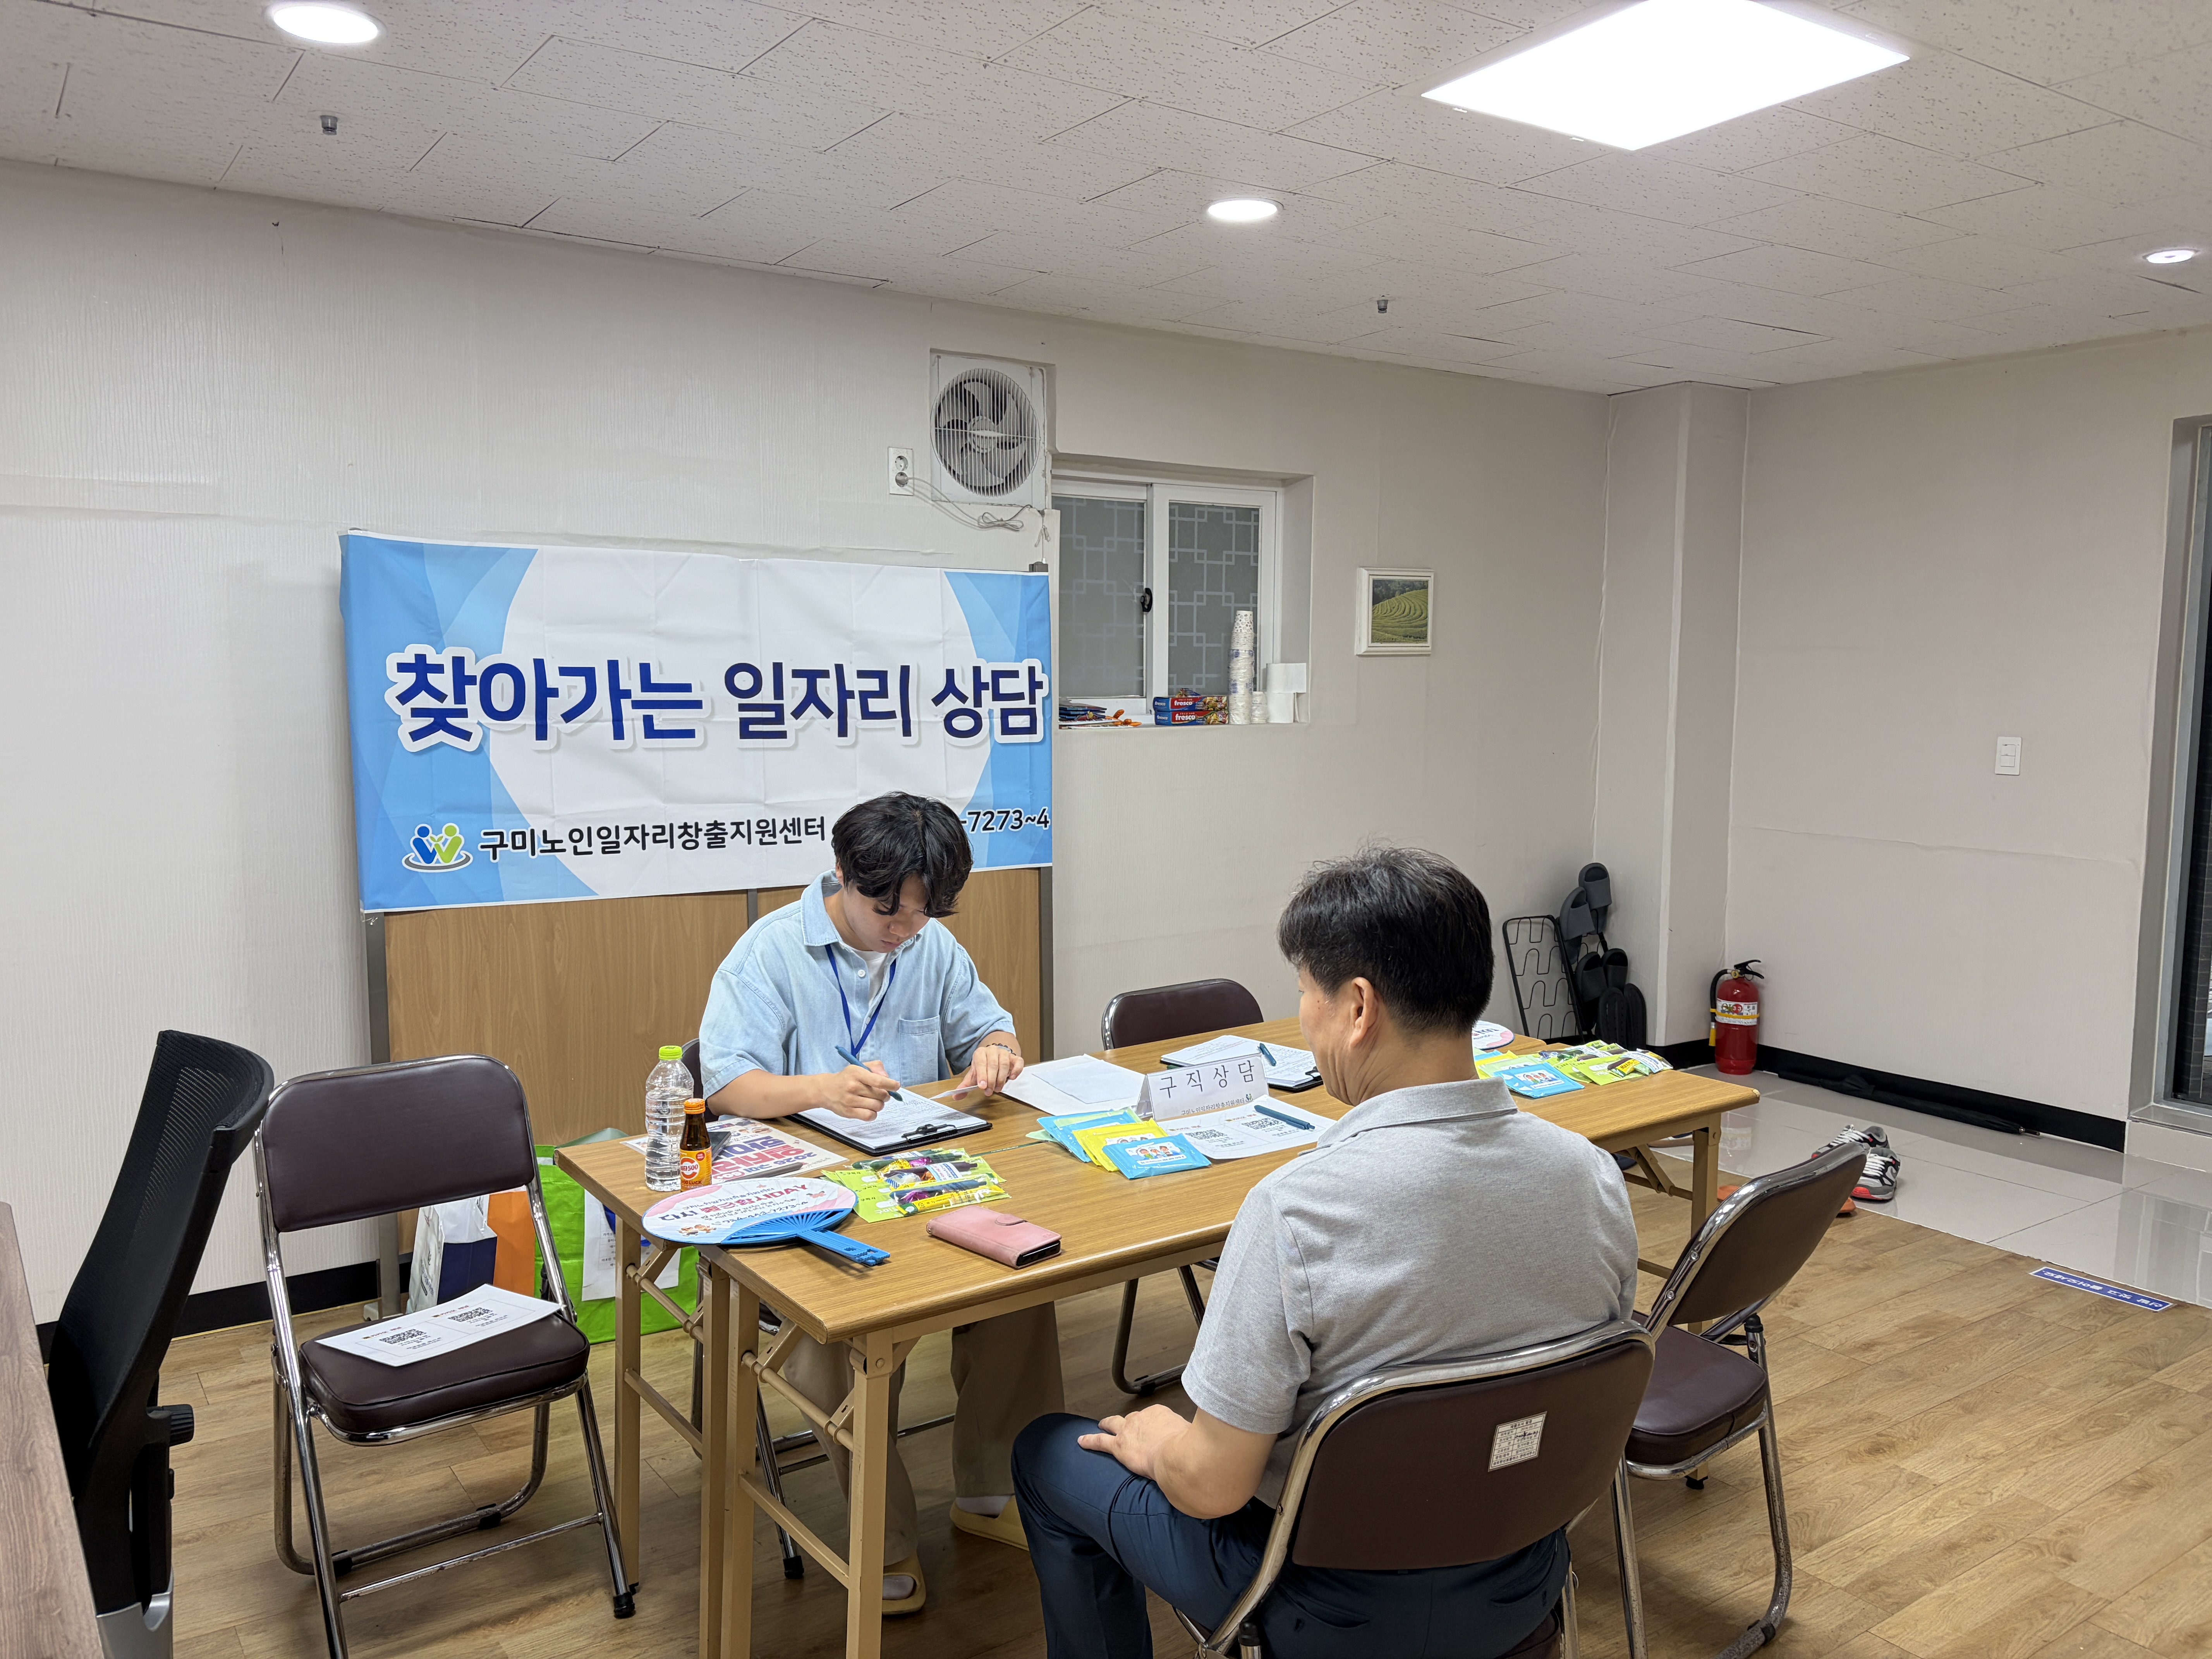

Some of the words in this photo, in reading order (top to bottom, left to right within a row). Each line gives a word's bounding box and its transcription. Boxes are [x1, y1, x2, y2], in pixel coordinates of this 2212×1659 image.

[396, 654, 702, 741] 찾아가는
[725, 663, 911, 739] 일자리
[932, 666, 1043, 738] 상담
[481, 817, 824, 860] 구미노인일자리창출지원센터
[1160, 1060, 1254, 1099] 구직상담
[712, 1144, 805, 1176] 일자리
[718, 1135, 787, 1159] 한마
[773, 1152, 817, 1165] 2026
[743, 1164, 773, 1173] 구미
[658, 1210, 698, 1221] 다시
